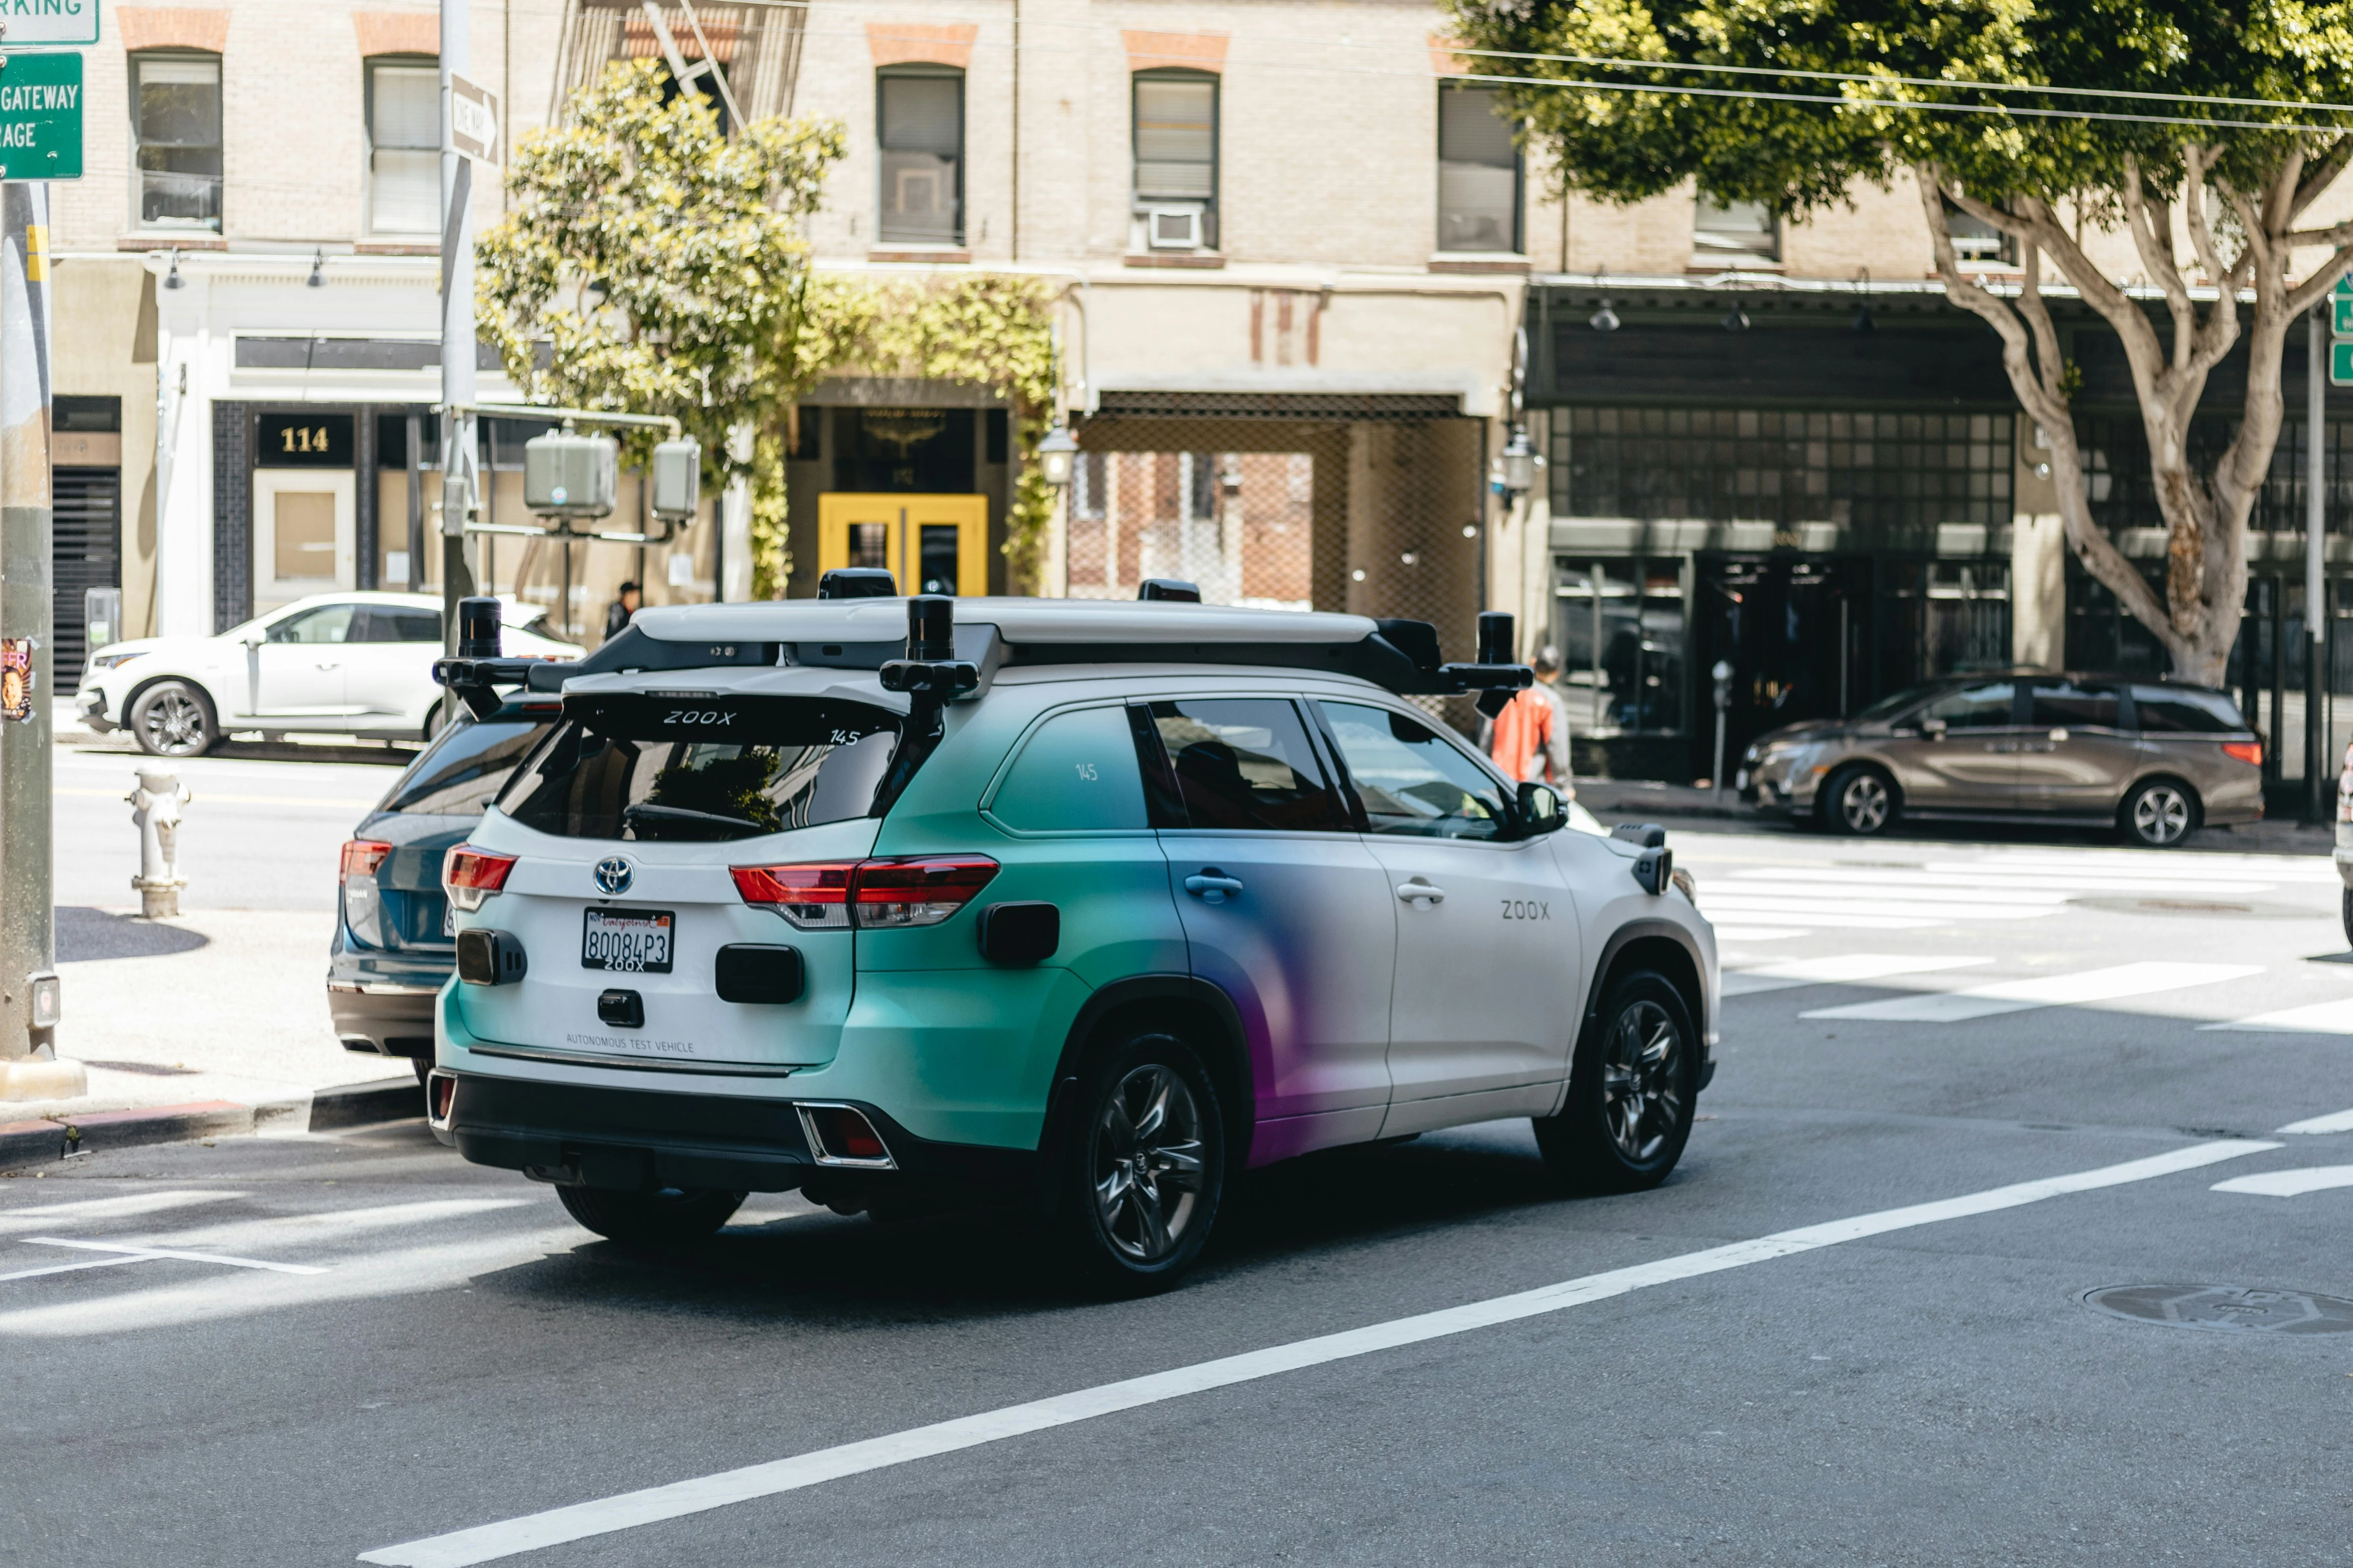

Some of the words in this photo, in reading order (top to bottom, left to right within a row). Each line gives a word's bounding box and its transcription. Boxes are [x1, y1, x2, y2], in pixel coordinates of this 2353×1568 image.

[1, 85, 78, 111] GATEWAY
[0, 123, 36, 148] AGE
[281, 426, 329, 452] 114
[664, 710, 737, 725] ZOOX
[830, 729, 860, 745] 145
[1076, 764, 1098, 781] 145
[1501, 900, 1550, 920] ZOOX
[588, 932, 666, 962] 80084P3
[604, 959, 645, 972] ZOOX
[566, 1034, 627, 1049] AUTONOMOUS
[629, 1039, 652, 1050] TEST
[655, 1041, 694, 1053] VEHICLE
